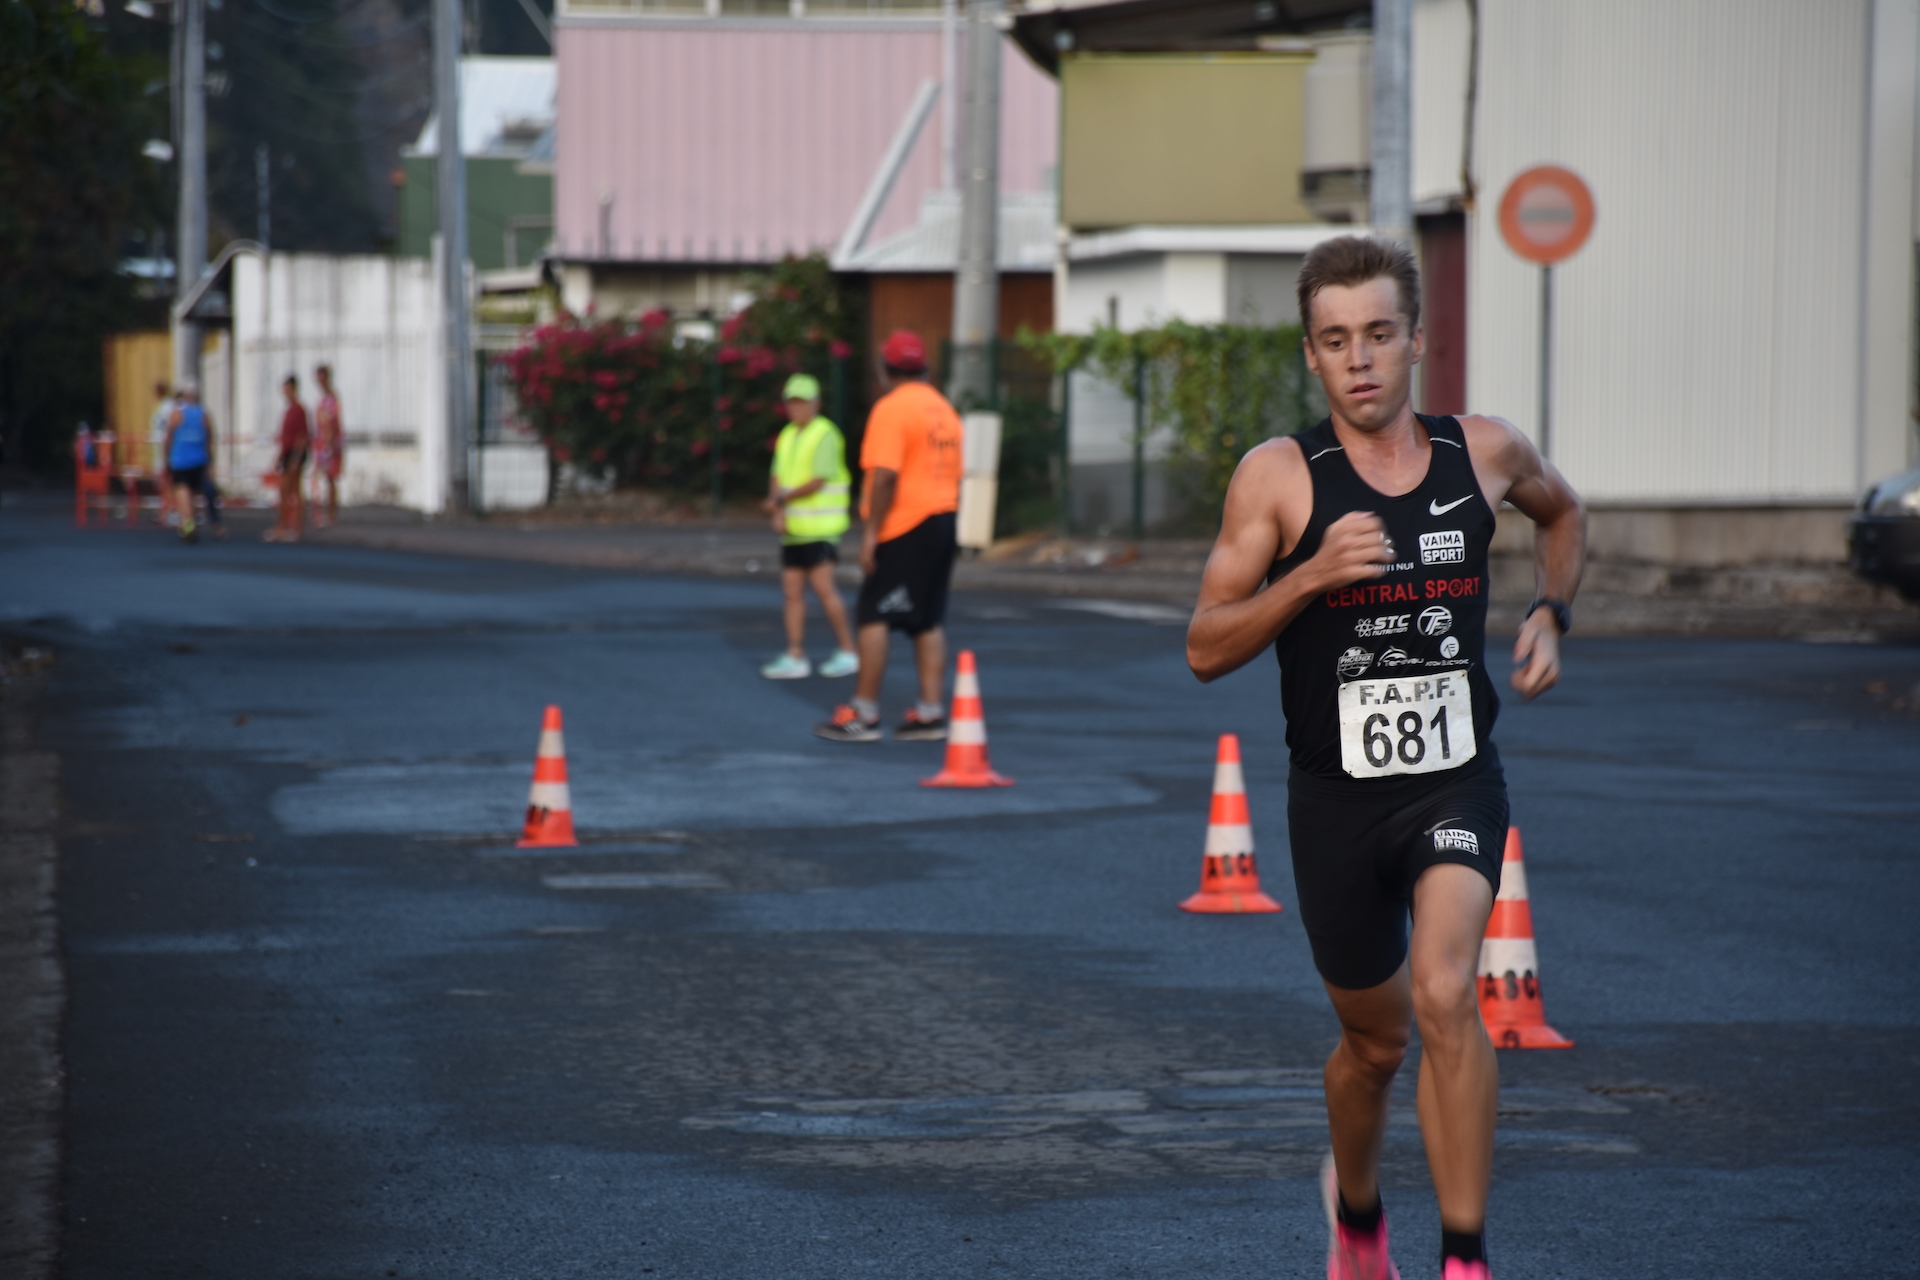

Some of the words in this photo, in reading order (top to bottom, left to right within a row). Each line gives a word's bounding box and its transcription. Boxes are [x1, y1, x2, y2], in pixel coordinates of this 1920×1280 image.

[1422, 533, 1461, 547] VAIMA
[1423, 548, 1463, 562] SPORT
[1396, 562, 1414, 571] NUI
[1326, 582, 1419, 608] CENTRAL
[1425, 577, 1480, 599] SPORT
[1374, 613, 1412, 630] STC
[1360, 677, 1455, 705] F.A.P.F.
[1363, 705, 1450, 768] 681
[1436, 830, 1475, 842] VAIMA
[1436, 839, 1477, 852] SPORT
